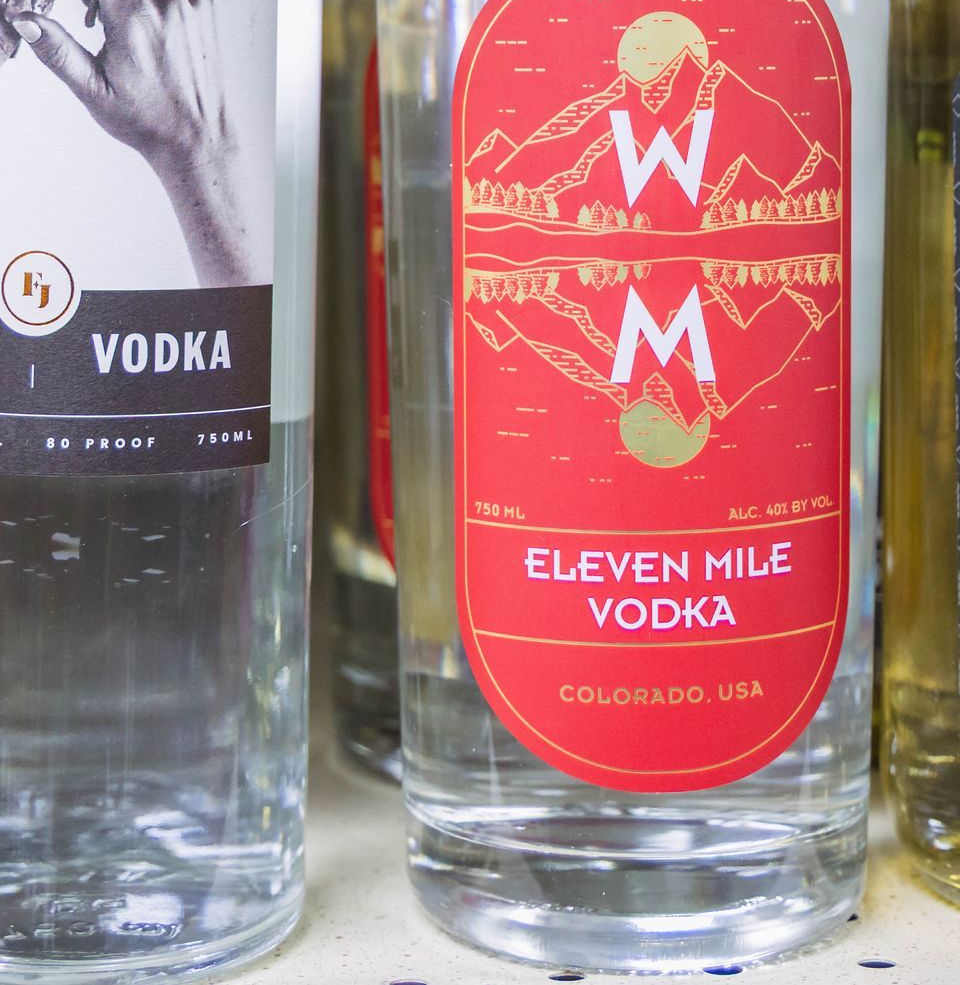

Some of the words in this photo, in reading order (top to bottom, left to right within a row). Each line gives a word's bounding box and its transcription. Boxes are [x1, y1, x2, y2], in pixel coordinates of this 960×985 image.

[609, 109, 714, 208] W
[92, 329, 232, 374] VODKA
[610, 284, 716, 384] M
[46, 437, 70, 449] 80
[86, 436, 155, 449] PROOF
[197, 430, 253, 446] 750ML
[475, 501, 500, 517] 750
[504, 508, 525, 520] ML
[728, 507, 762, 520] ALC.
[766, 502, 788, 516] 40%
[792, 498, 808, 514] BY
[811, 495, 835, 509] VOL.
[525, 547, 689, 584] ELEVEN
[706, 541, 792, 581] MILE
[588, 595, 736, 630] VODKA
[560, 684, 712, 705] COLORADO,
[719, 680, 763, 701] USA
